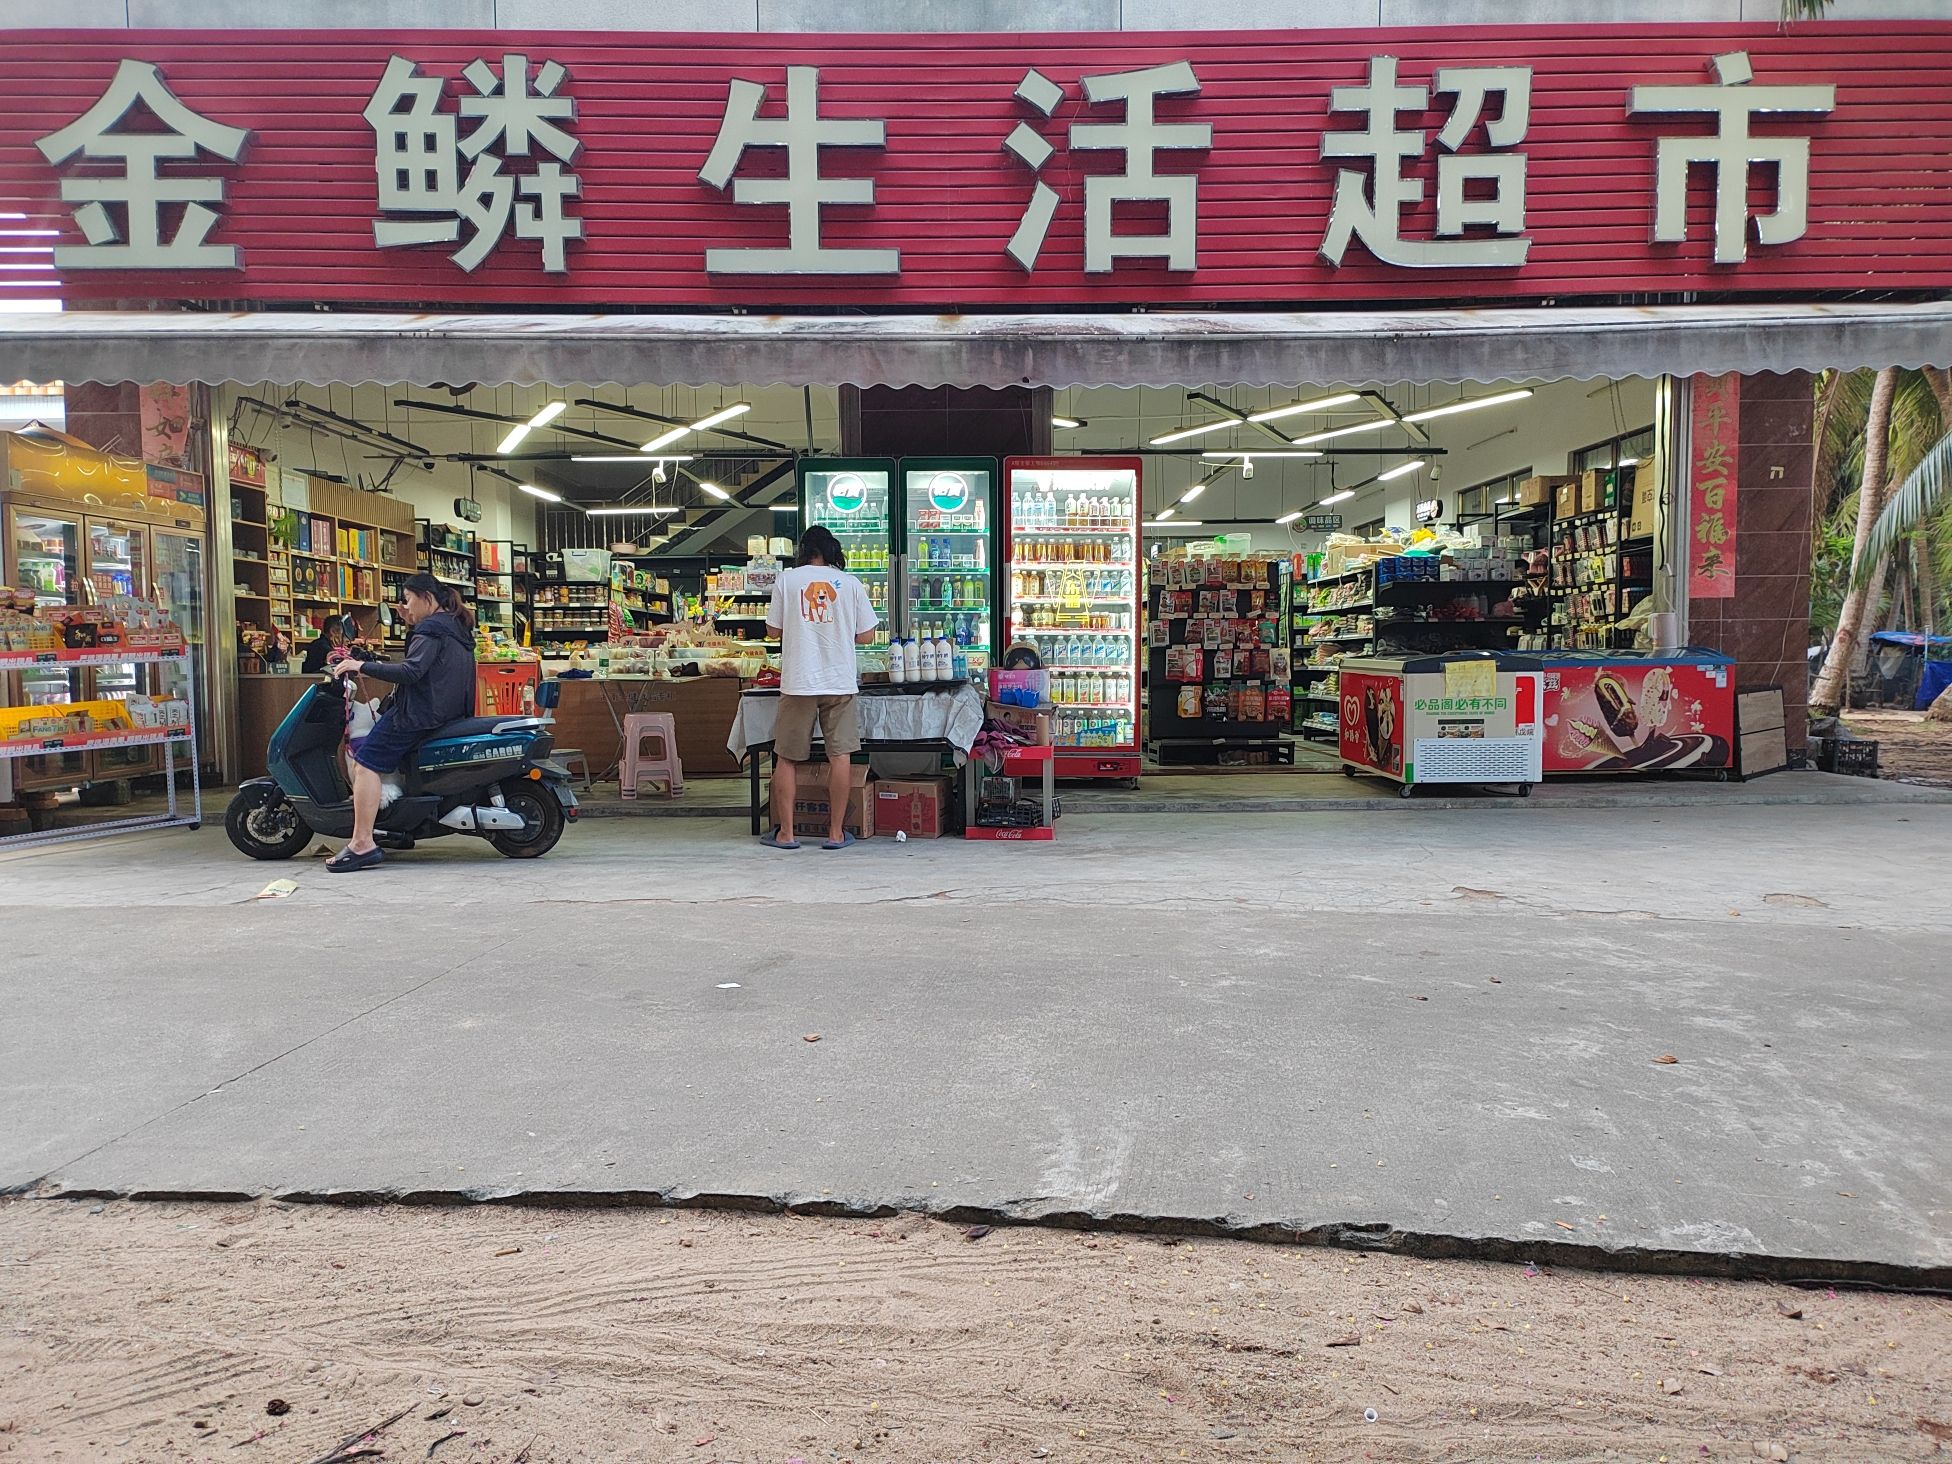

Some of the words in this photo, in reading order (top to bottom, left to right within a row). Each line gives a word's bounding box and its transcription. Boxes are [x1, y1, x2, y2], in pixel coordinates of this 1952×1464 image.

[34, 51, 1837, 274] 金鳞生活超市
[1414, 698, 1507, 710] 必品阁必有不同
